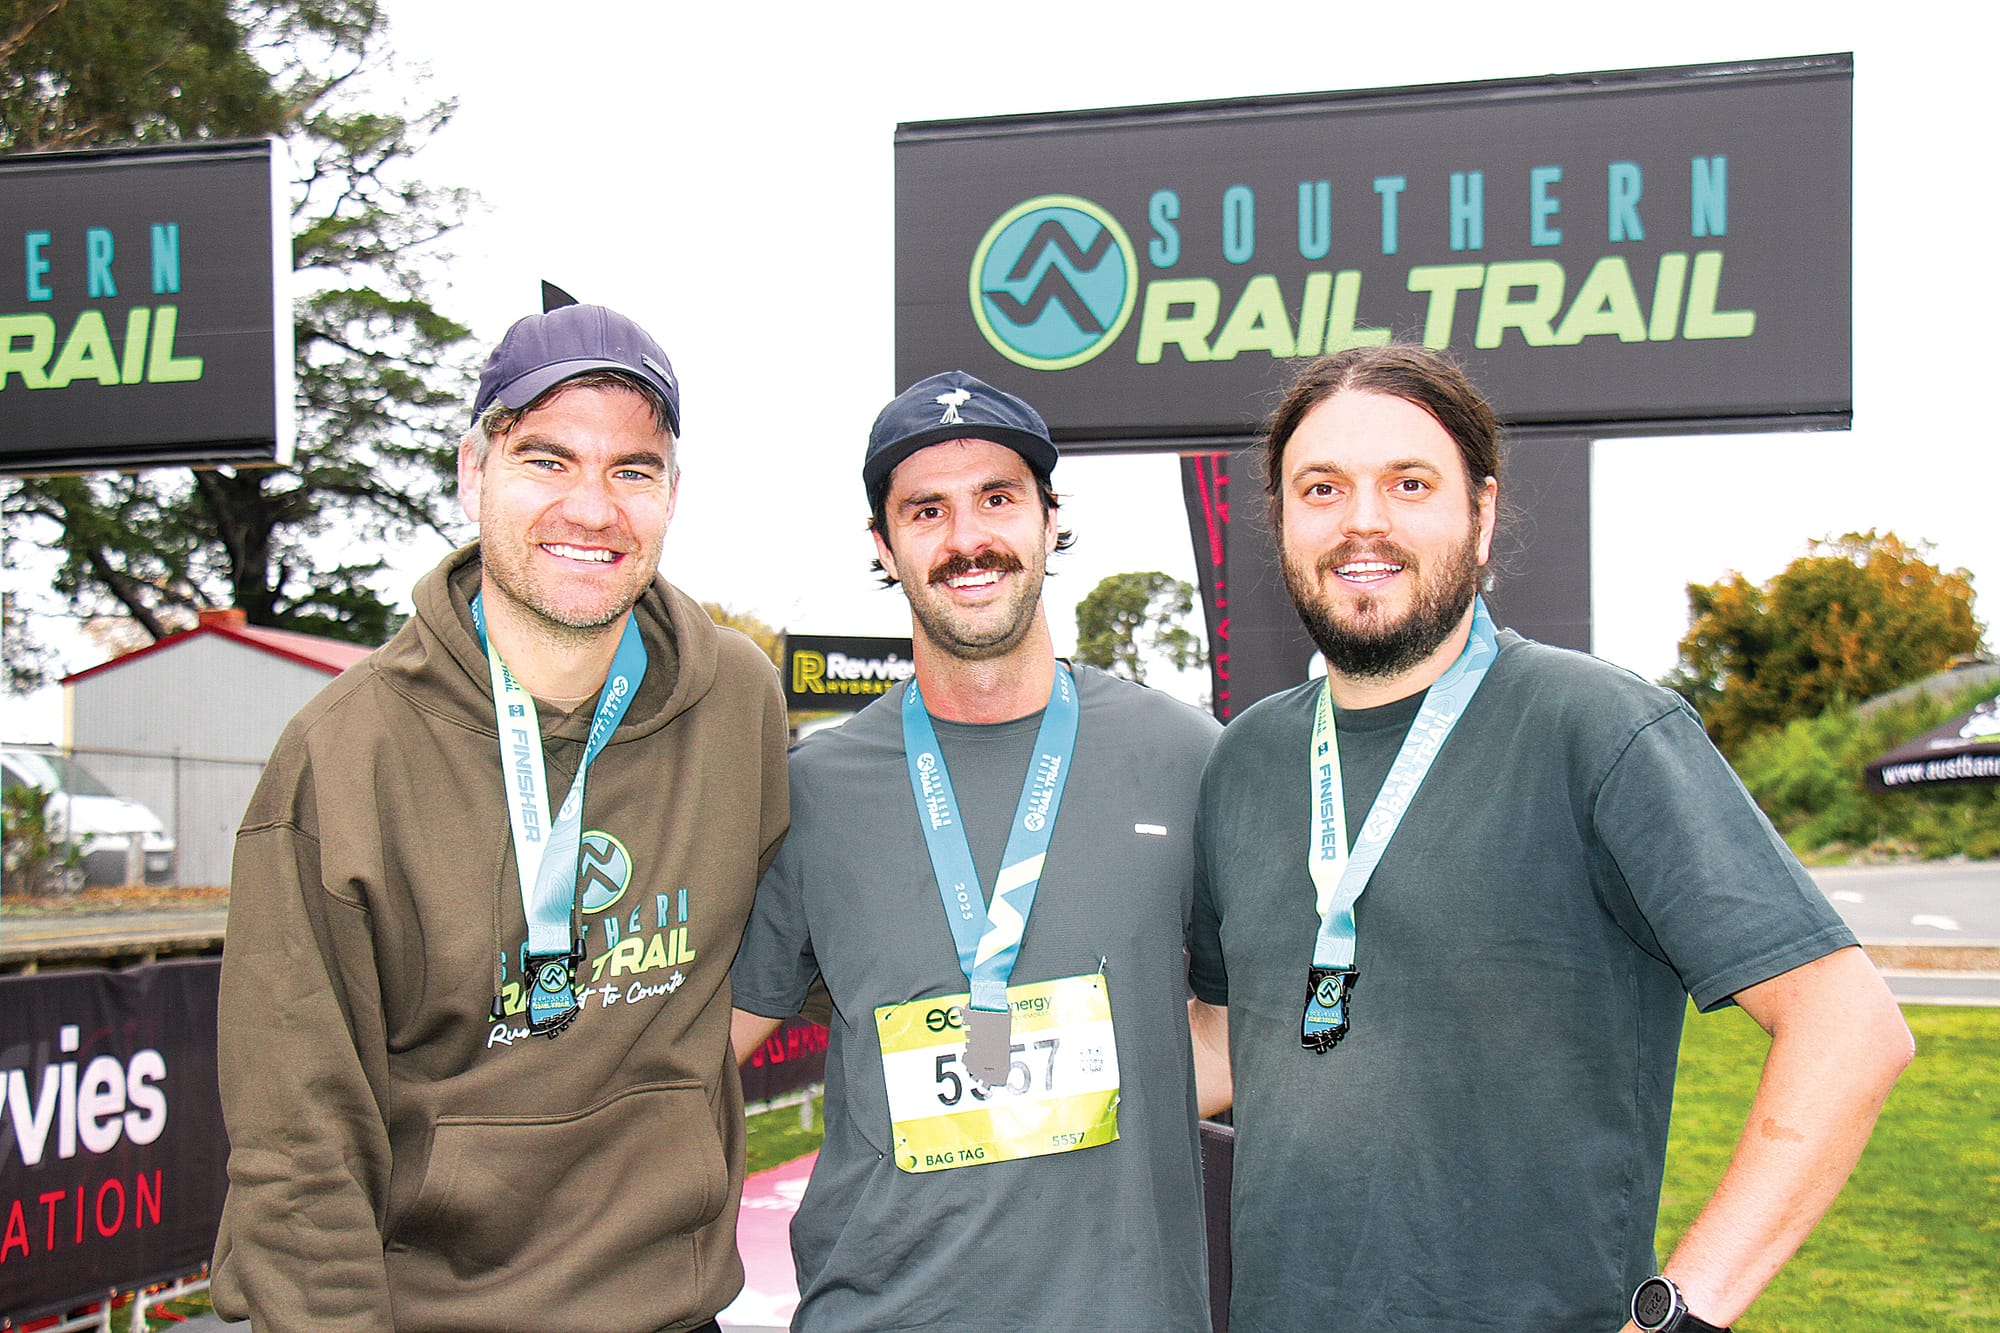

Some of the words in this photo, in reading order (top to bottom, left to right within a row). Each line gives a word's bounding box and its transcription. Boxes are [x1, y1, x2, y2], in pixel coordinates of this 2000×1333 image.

[1147, 153, 1729, 269] SOUTHERN
[25, 222, 181, 301] ERN
[1135, 269, 1393, 365] RAIL
[1406, 249, 1757, 351] TRAIL
[0, 304, 205, 391] RAIL
[826, 652, 915, 681] Revvie
[511, 728, 541, 845] FINISHER
[1045, 755, 1062, 788] TRAIL
[926, 796, 943, 831] TRAIL
[1319, 763, 1337, 861] FINISHER
[954, 882, 974, 921] 2025
[592, 926, 697, 983] TRAIL
[599, 982, 622, 1008] to
[1007, 996, 1052, 1013] nergy
[934, 1037, 1061, 1107] 557
[925, 1149, 955, 1166] BAG
[957, 1147, 985, 1162] TAG
[1052, 1132, 1086, 1147] 5557
[0, 1168, 163, 1264] ATION
